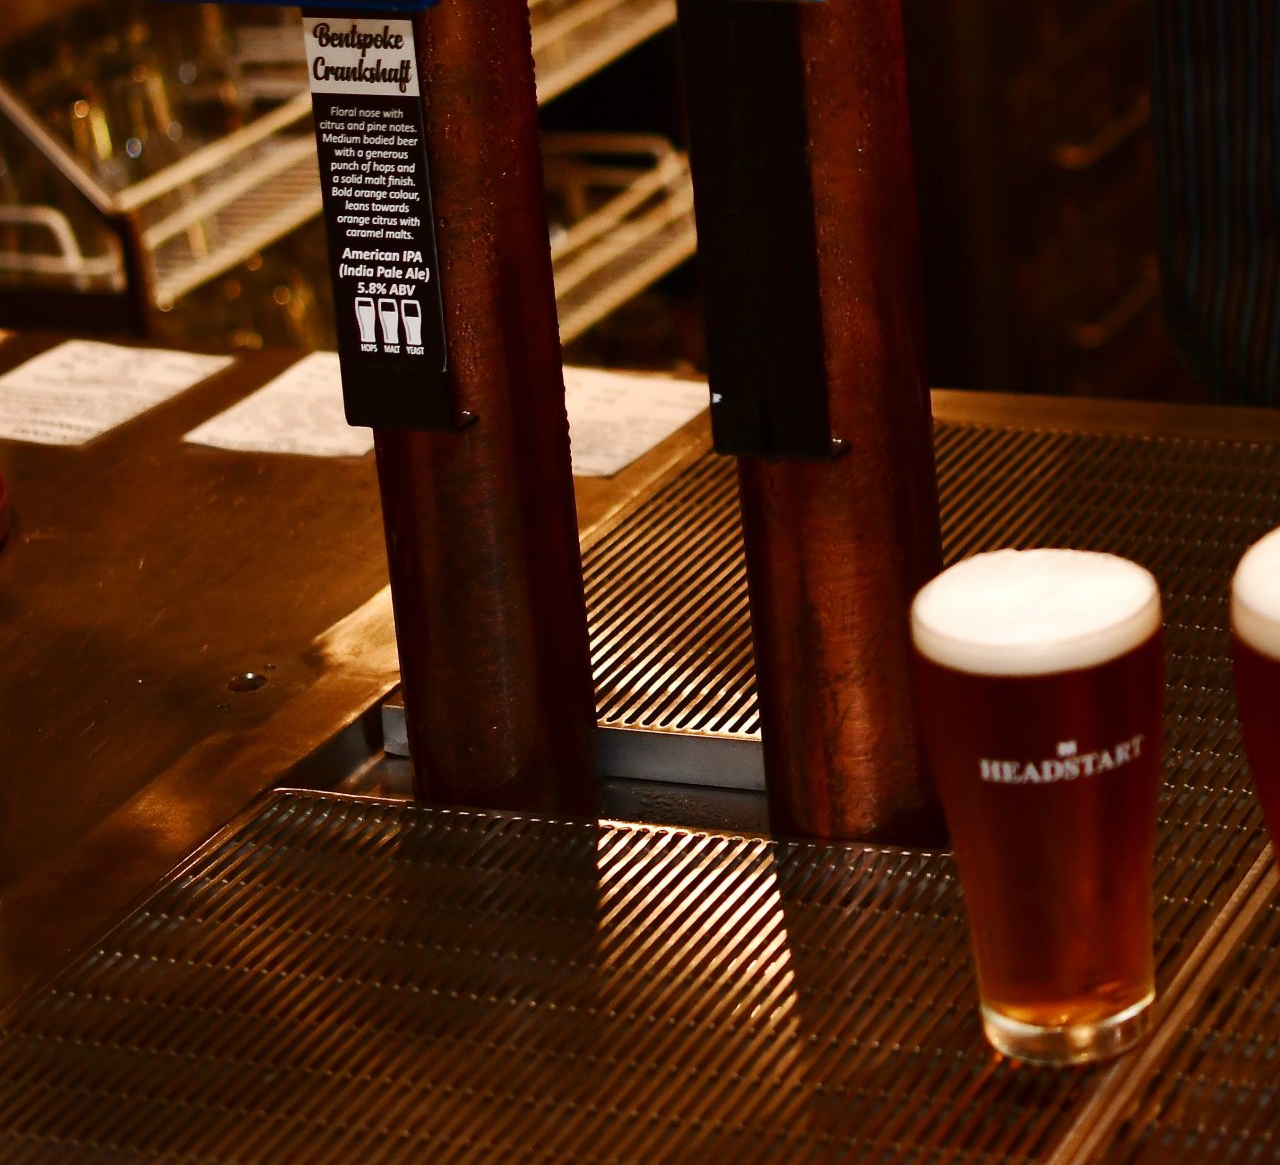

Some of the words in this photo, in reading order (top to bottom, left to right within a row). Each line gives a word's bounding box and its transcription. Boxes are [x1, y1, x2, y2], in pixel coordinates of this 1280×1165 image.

[312, 22, 405, 57] Bentspoke
[312, 56, 412, 93] Crankshaft
[330, 106, 357, 117] Floral
[359, 108, 381, 118] nose
[383, 109, 404, 119] with
[320, 120, 345, 130] citrus
[347, 121, 365, 131] and
[367, 122, 387, 132] pine
[389, 123, 418, 133] notes.
[322, 133, 361, 144] Medium
[363, 134, 394, 145] bodied
[397, 136, 418, 146] beer
[334, 147, 355, 157] with
[357, 149, 364, 157] a
[365, 149, 409, 160] generous
[330, 161, 359, 172] punch
[361, 162, 371, 173] of
[373, 162, 395, 174] hops
[397, 163, 415, 173] and
[333, 175, 339, 183] a
[341, 174, 362, 184] solid
[364, 175, 386, 185] malt
[387, 175, 416, 187] finish.
[332, 187, 352, 197] Bold
[354, 189, 387, 200] orange
[389, 190, 420, 201] colour,
[345, 201, 369, 211] leans
[371, 202, 410, 213] towards
[337, 215, 370, 226] orange
[372, 215, 397, 226] citrus
[400, 217, 420, 227] with
[346, 228, 384, 238] caramel
[385, 229, 414, 240] malts.
[342, 247, 400, 261] American
[402, 250, 423, 263] IPA
[339, 263, 374, 278] (India
[376, 266, 403, 279] Pale
[405, 267, 430, 283] Ale)
[357, 282, 387, 295] 5.8%
[389, 283, 416, 296] ABV
[361, 344, 378, 353] HOPS
[384, 344, 400, 354] MALT
[406, 346, 424, 355] YEAST
[979, 733, 1145, 784] HEADSTART
